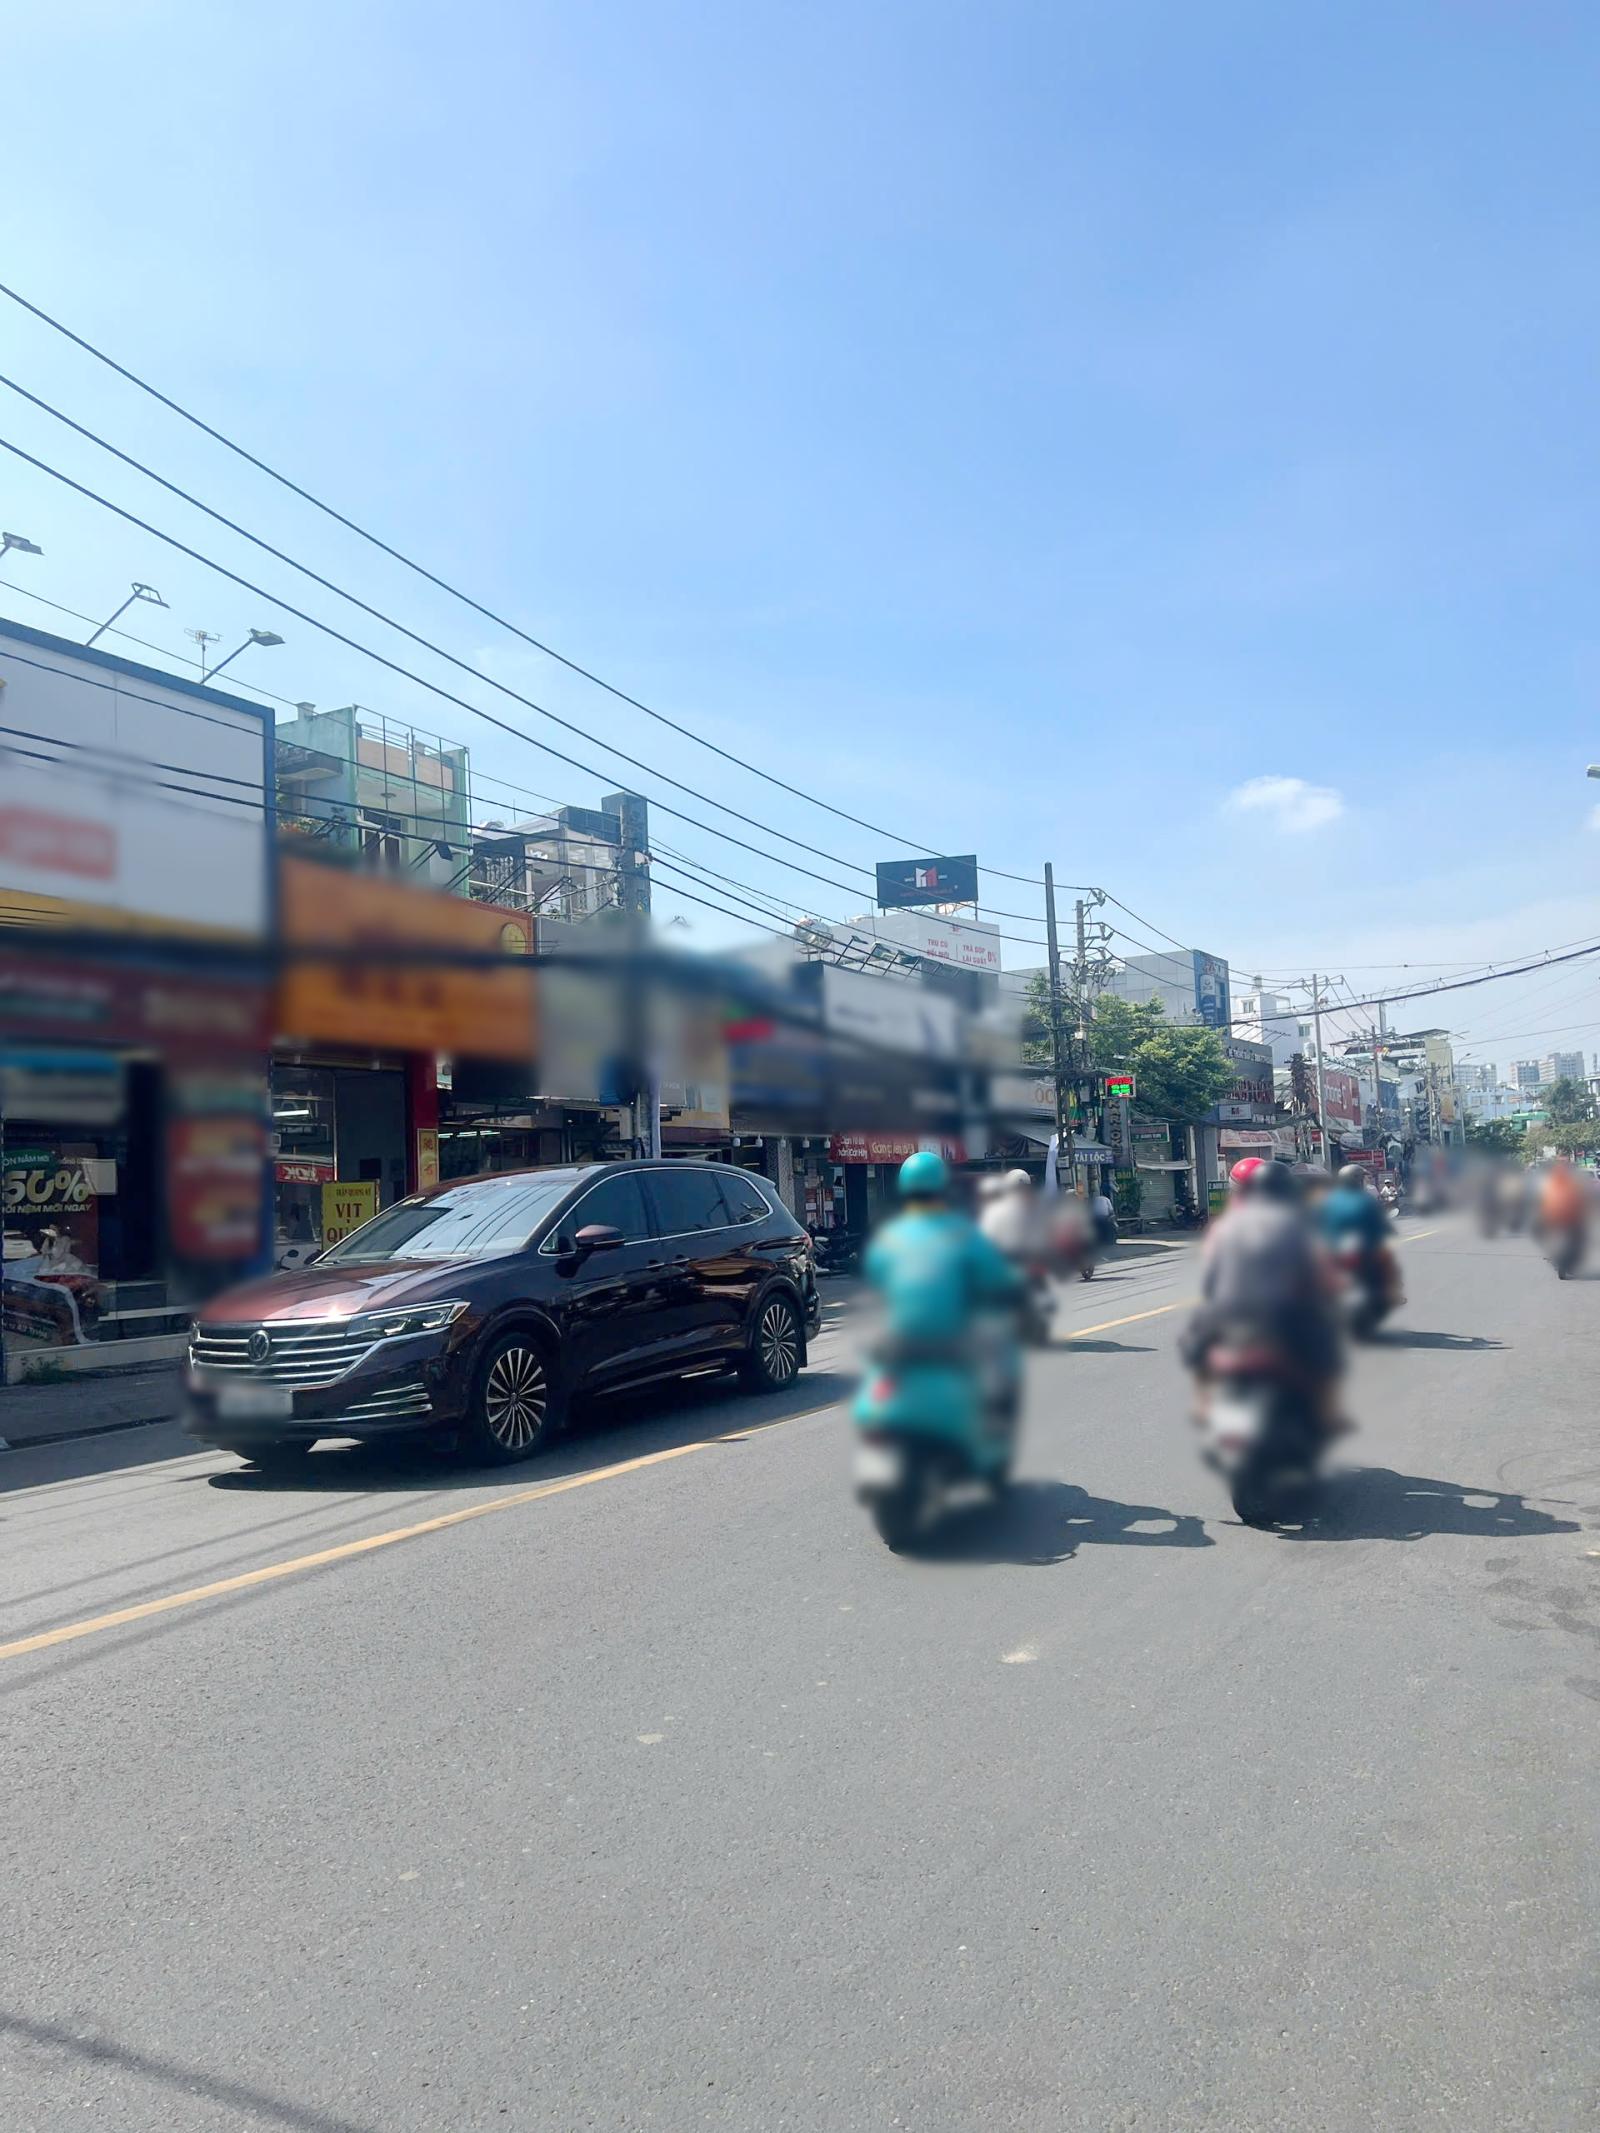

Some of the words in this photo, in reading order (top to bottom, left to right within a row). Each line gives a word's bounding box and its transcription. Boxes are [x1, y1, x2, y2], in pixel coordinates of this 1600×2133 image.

[1074, 1150, 1088, 1162] TÀI
[1089, 1151, 1105, 1163] LỘC
[3, 1170, 90, 1204] 50%
[64, 1204, 92, 1212] NGAY
[335, 1203, 362, 1223] VỊT
